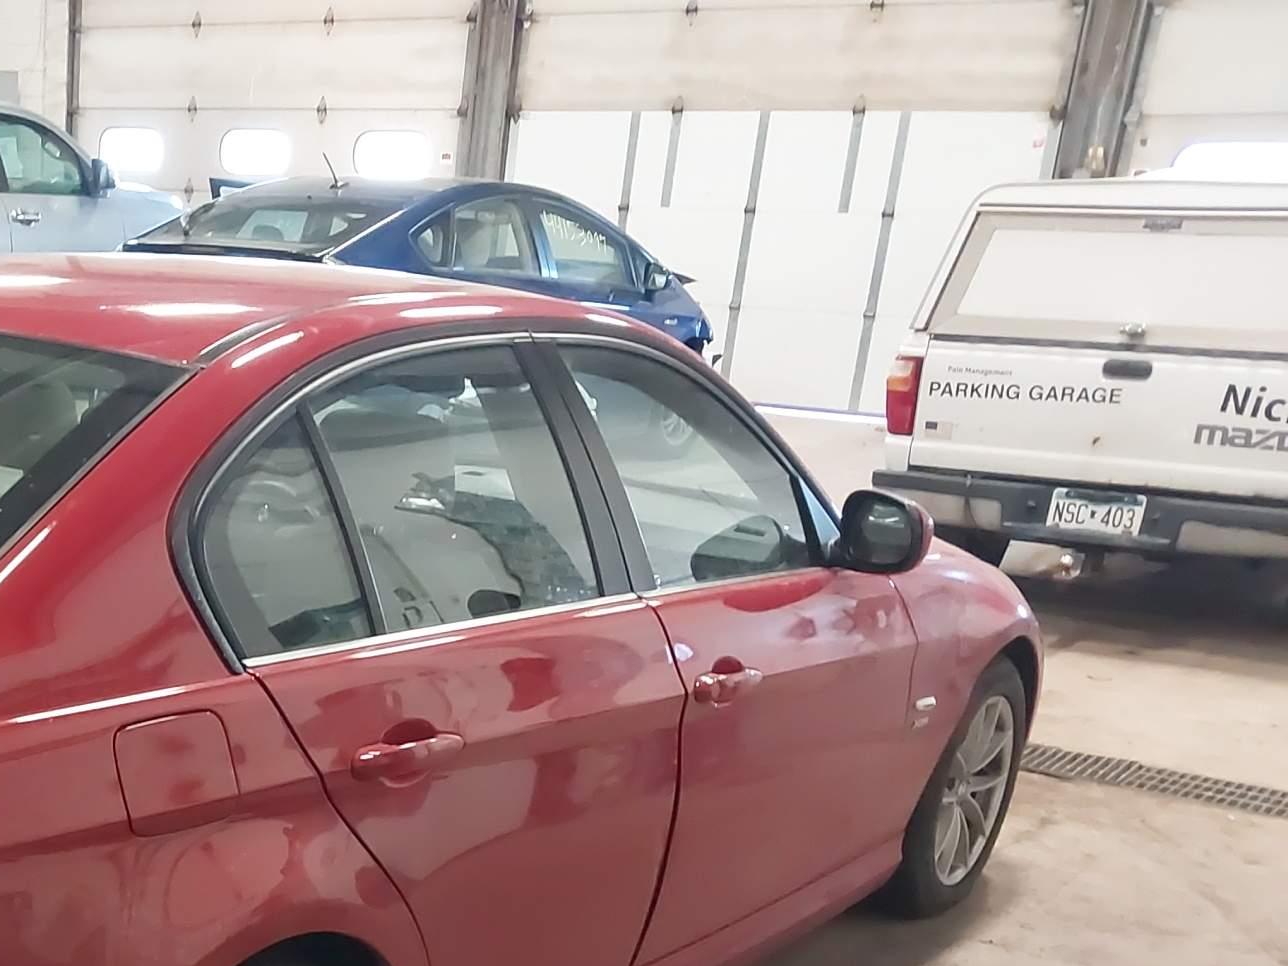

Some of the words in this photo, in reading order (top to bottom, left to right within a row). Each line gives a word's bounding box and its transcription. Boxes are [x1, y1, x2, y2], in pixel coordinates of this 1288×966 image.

[929, 381, 1021, 400] PARKING
[1029, 385, 1123, 404] GARAGE
[1220, 383, 1288, 424] Nic
[1052, 501, 1089, 525] NSC
[1100, 505, 1136, 529] 403
